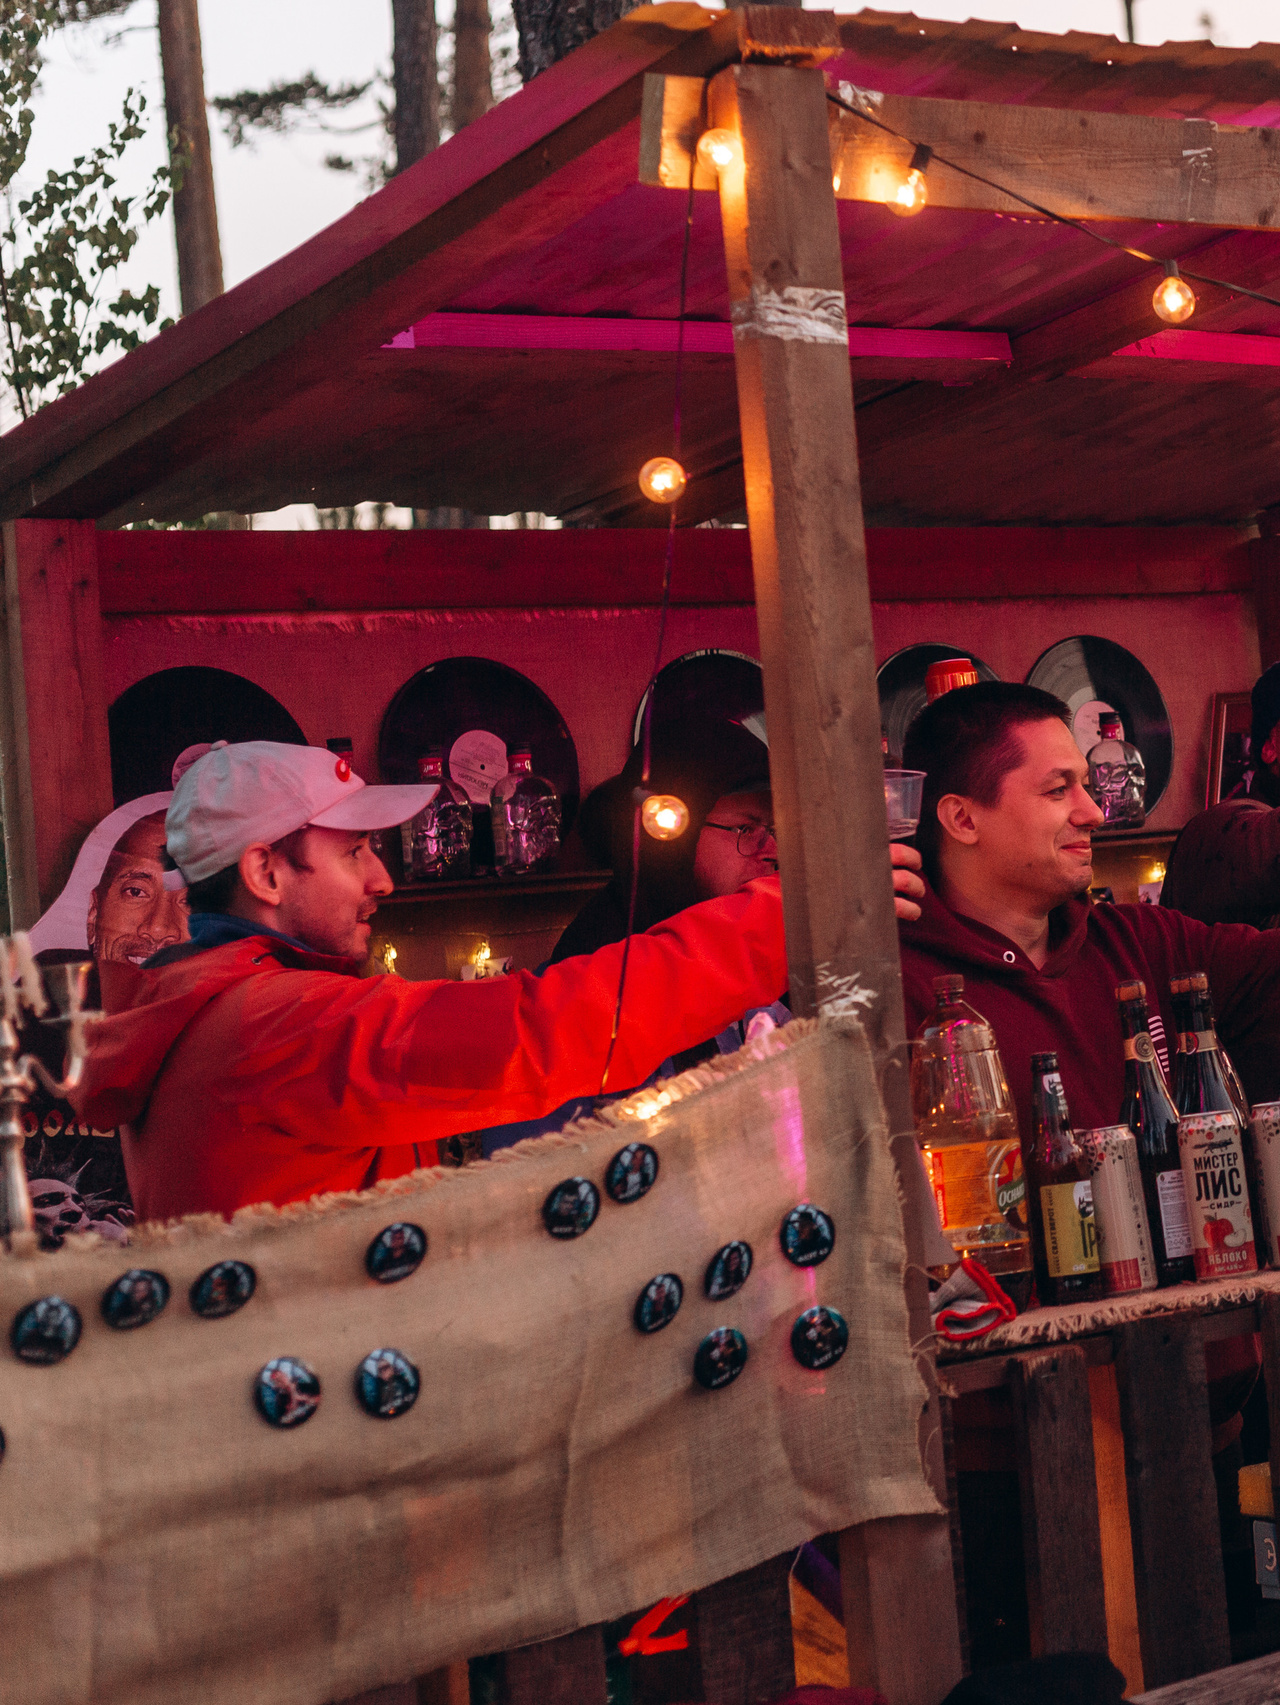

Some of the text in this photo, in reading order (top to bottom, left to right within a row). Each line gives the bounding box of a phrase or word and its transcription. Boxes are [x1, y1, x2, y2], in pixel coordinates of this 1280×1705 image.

[1193, 1151, 1239, 1172] МИСТЕР
[1195, 1167, 1242, 1201] ЛИС
[1209, 1200, 1236, 1211] СИДР
[1208, 1250, 1248, 1266] ЯБЛОКО
